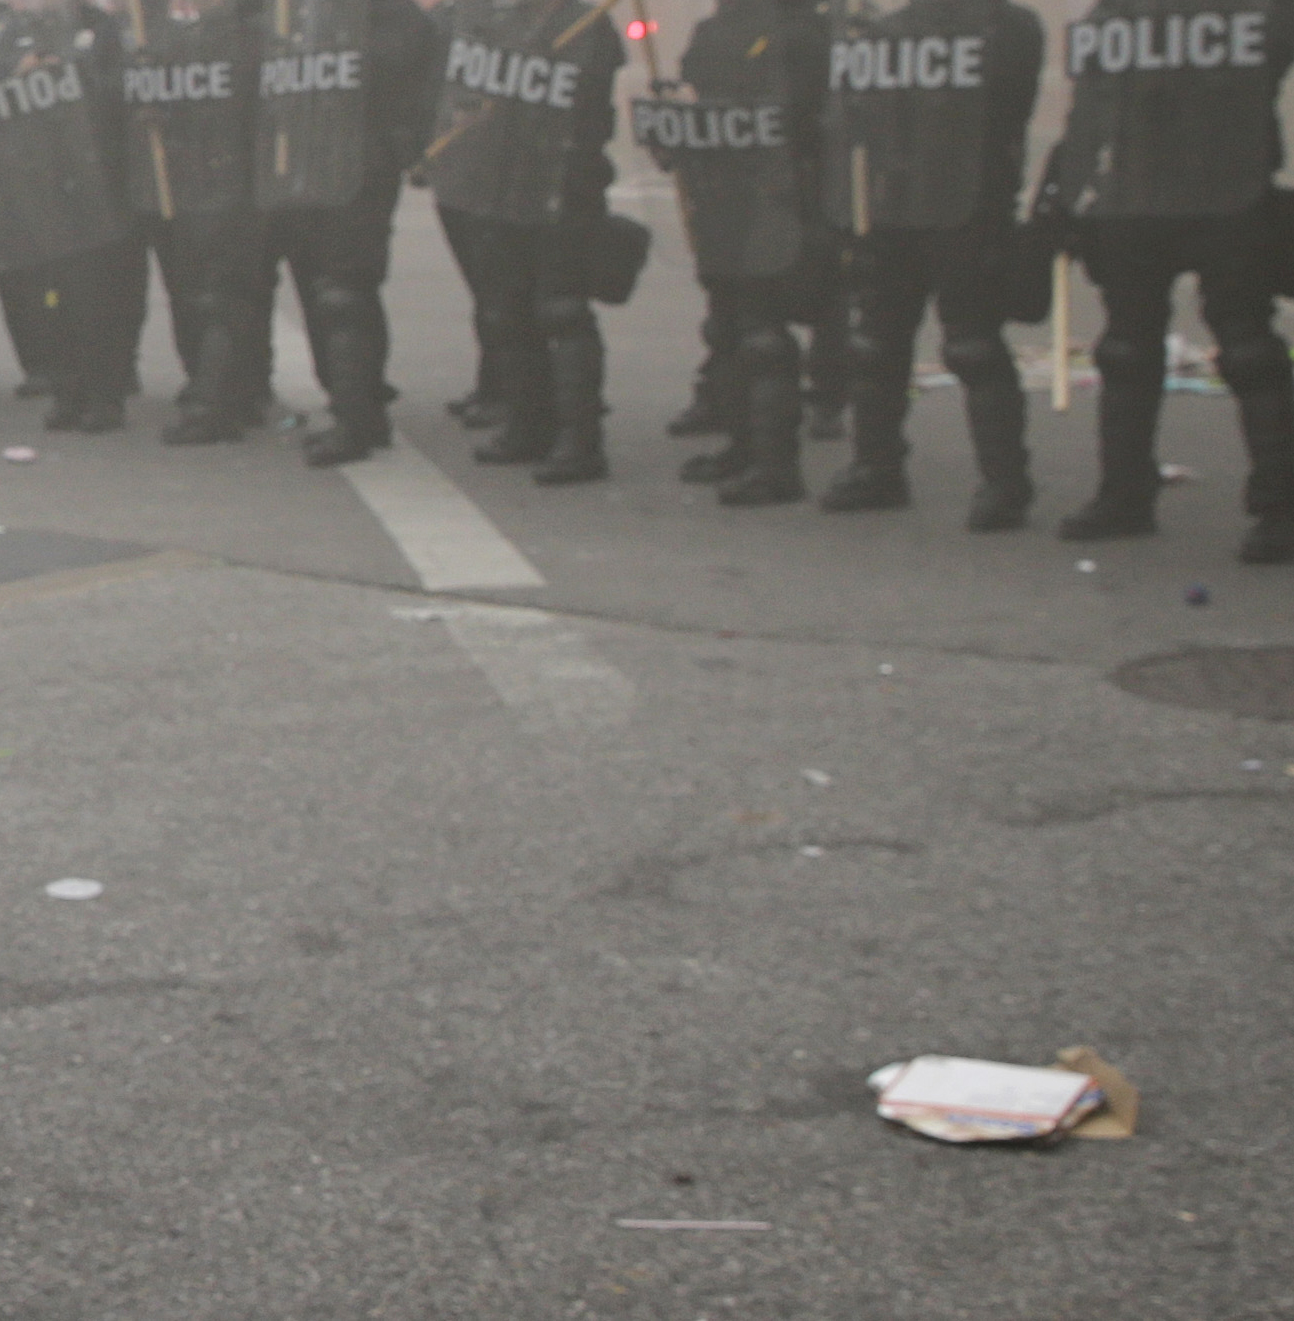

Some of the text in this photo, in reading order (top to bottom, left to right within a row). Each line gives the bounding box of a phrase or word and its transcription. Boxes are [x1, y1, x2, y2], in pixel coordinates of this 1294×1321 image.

[829, 34, 986, 91] POLICE
[1069, 11, 1266, 75] POLICE
[124, 60, 234, 102] POLICE
[260, 51, 362, 99] POLICE
[446, 38, 582, 109] POLICE
[632, 104, 785, 149] POLICE
